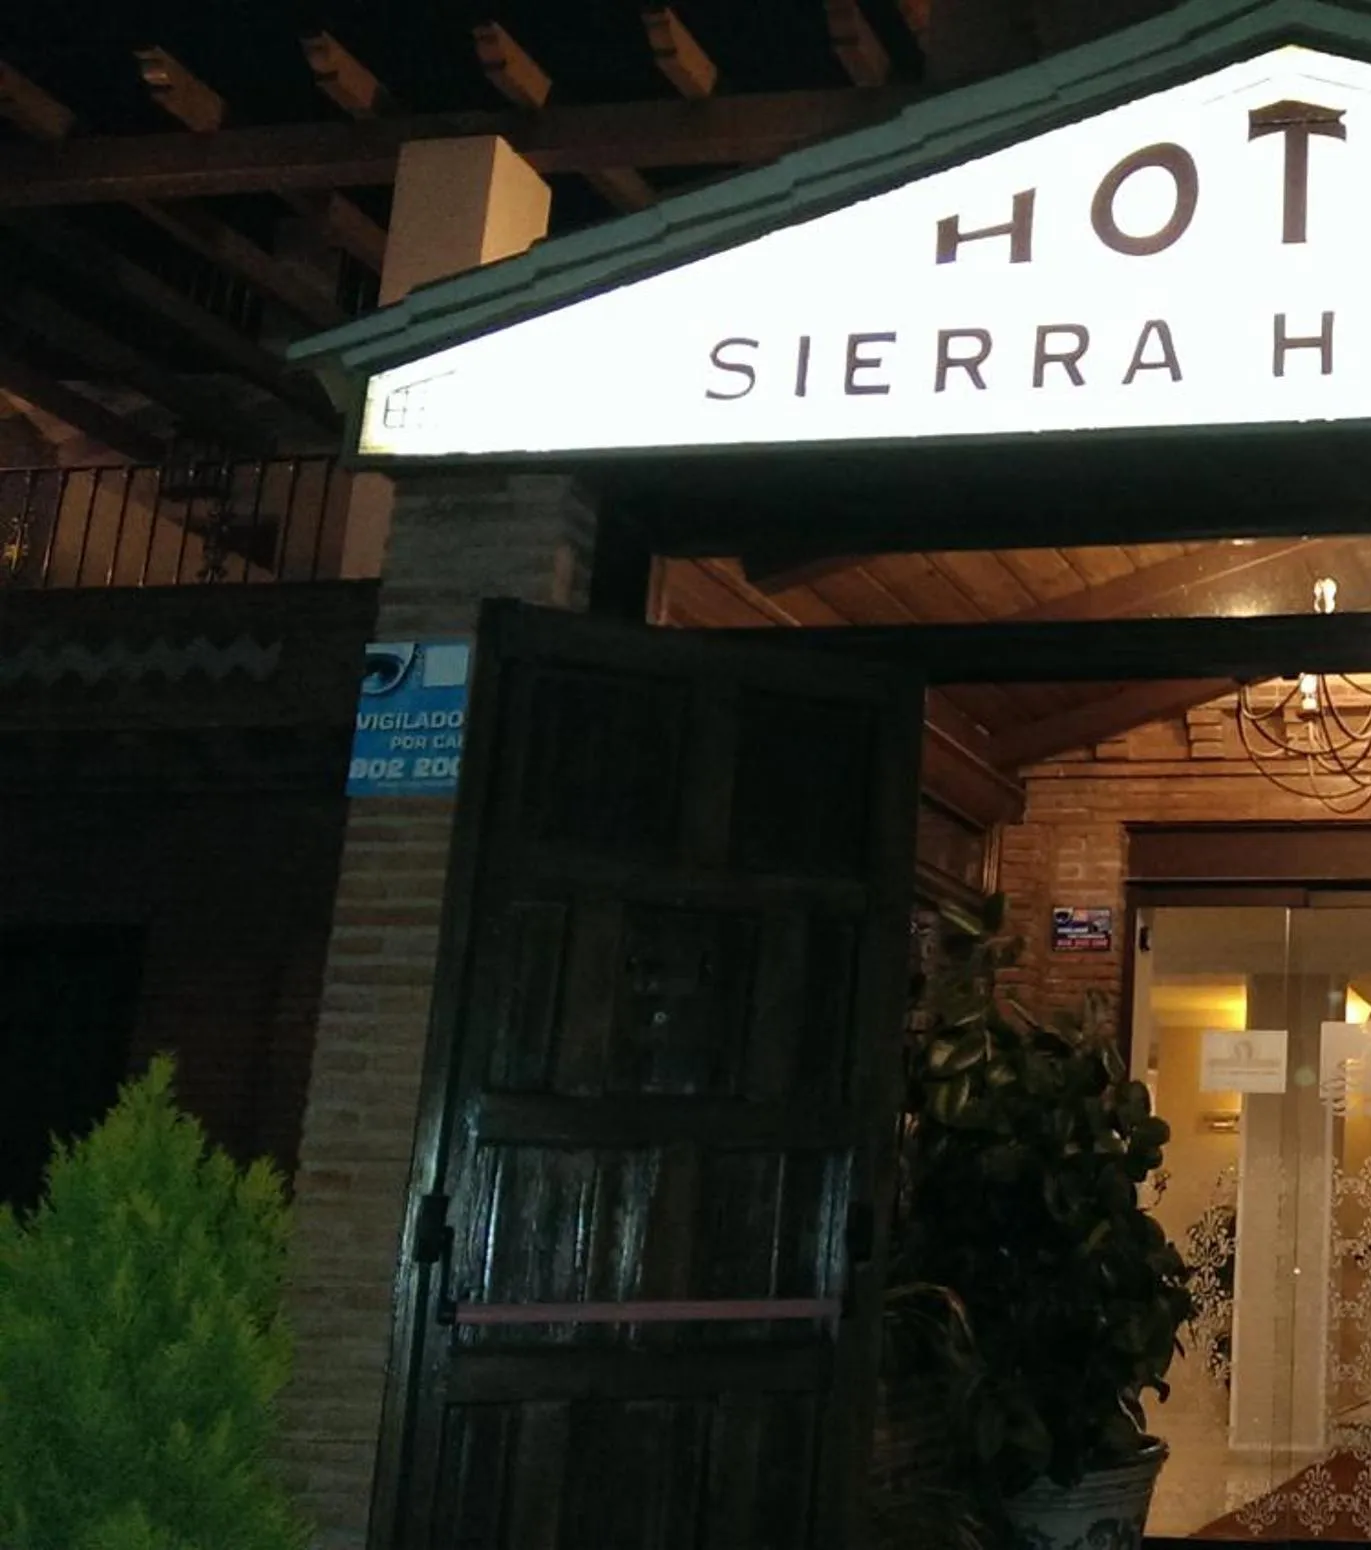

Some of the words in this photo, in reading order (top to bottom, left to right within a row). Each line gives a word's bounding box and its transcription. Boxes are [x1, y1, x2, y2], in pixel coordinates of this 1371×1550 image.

[705, 319, 1183, 400] SIERRA
[356, 711, 464, 730] VIGILADO
[390, 736, 428, 749] POR
[433, 735, 462, 749] CA
